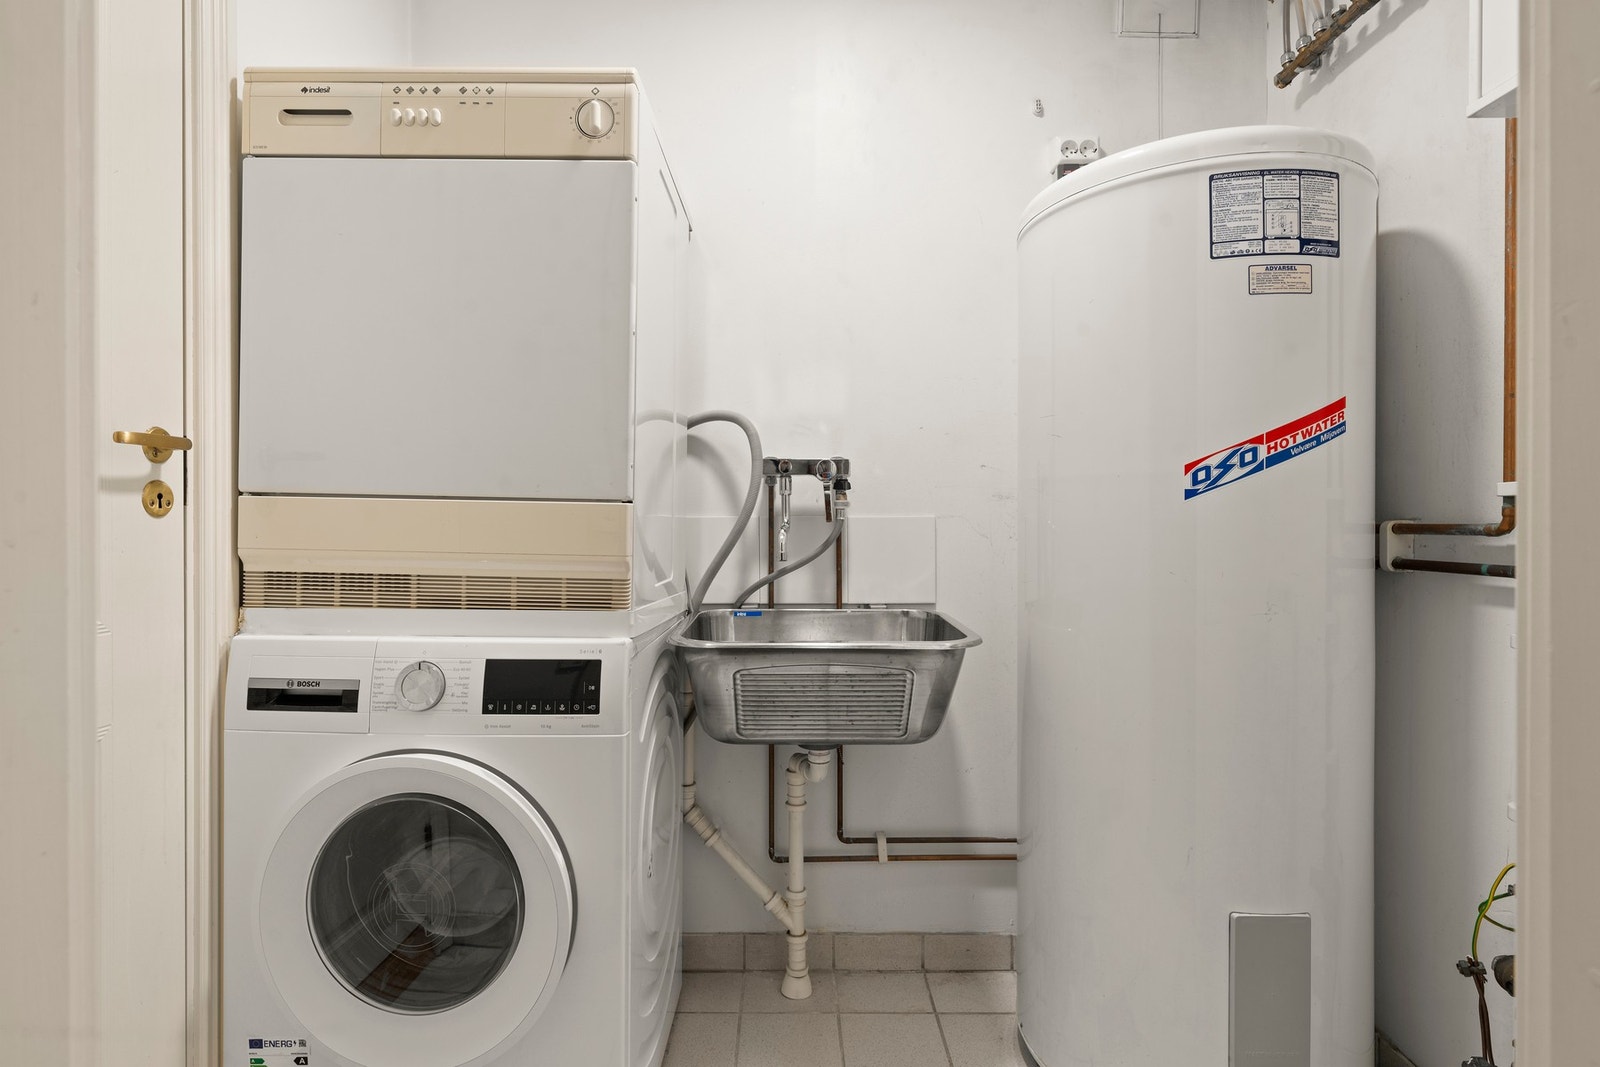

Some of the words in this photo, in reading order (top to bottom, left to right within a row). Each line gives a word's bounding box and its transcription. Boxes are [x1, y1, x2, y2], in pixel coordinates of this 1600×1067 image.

[1213, 170, 1260, 179] BRUKSANVISNING
[297, 680, 320, 688] BOSCH
[264, 1039, 292, 1048] ENERG
